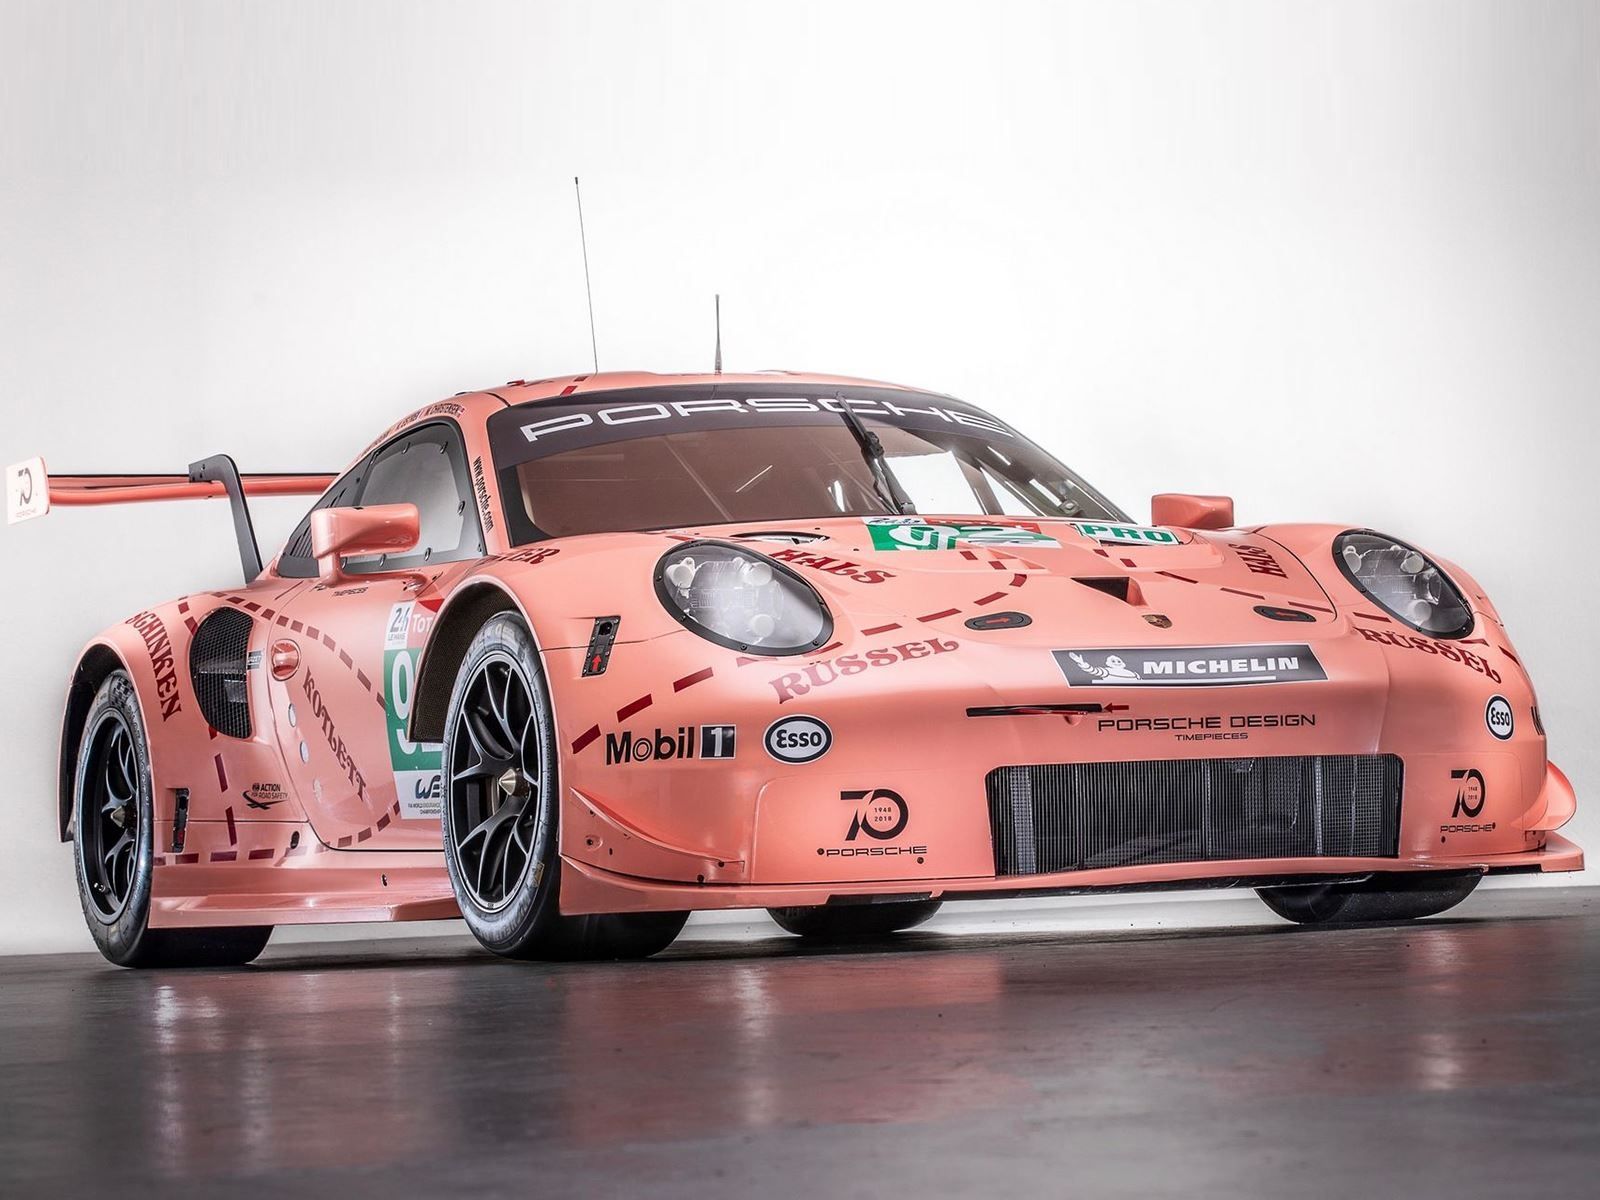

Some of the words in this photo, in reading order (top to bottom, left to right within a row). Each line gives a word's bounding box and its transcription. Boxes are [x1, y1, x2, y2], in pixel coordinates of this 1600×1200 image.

[520, 398, 1013, 441] PORSCHE
[472, 456, 494, 533] www.porsche.com
[1080, 524, 1173, 543] PRO
[769, 548, 896, 584] HALS
[1228, 543, 1289, 579] HALS
[412, 614, 432, 633] TOT
[126, 610, 182, 722] SCHINKEN
[1143, 657, 1299, 675] MICHELIN
[1352, 626, 1502, 684] RÜSSEL
[769, 638, 960, 704] RÜSSEL
[1098, 716, 1221, 732] PORSCHE
[1230, 714, 1316, 728] DESIGN
[1490, 707, 1510, 726] Esso
[302, 666, 367, 801] KOTLETT
[606, 726, 695, 765] Mobil
[710, 727, 722, 757] 1
[776, 729, 823, 748] Esso
[1174, 732, 1249, 741] TIMEPIECES
[260, 784, 281, 792] ACTION
[415, 775, 441, 800] WE
[1450, 768, 1486, 818] 70
[840, 788, 909, 841] 70
[1440, 824, 1492, 833] PORSCHE
[826, 846, 928, 858] PORSCHE
